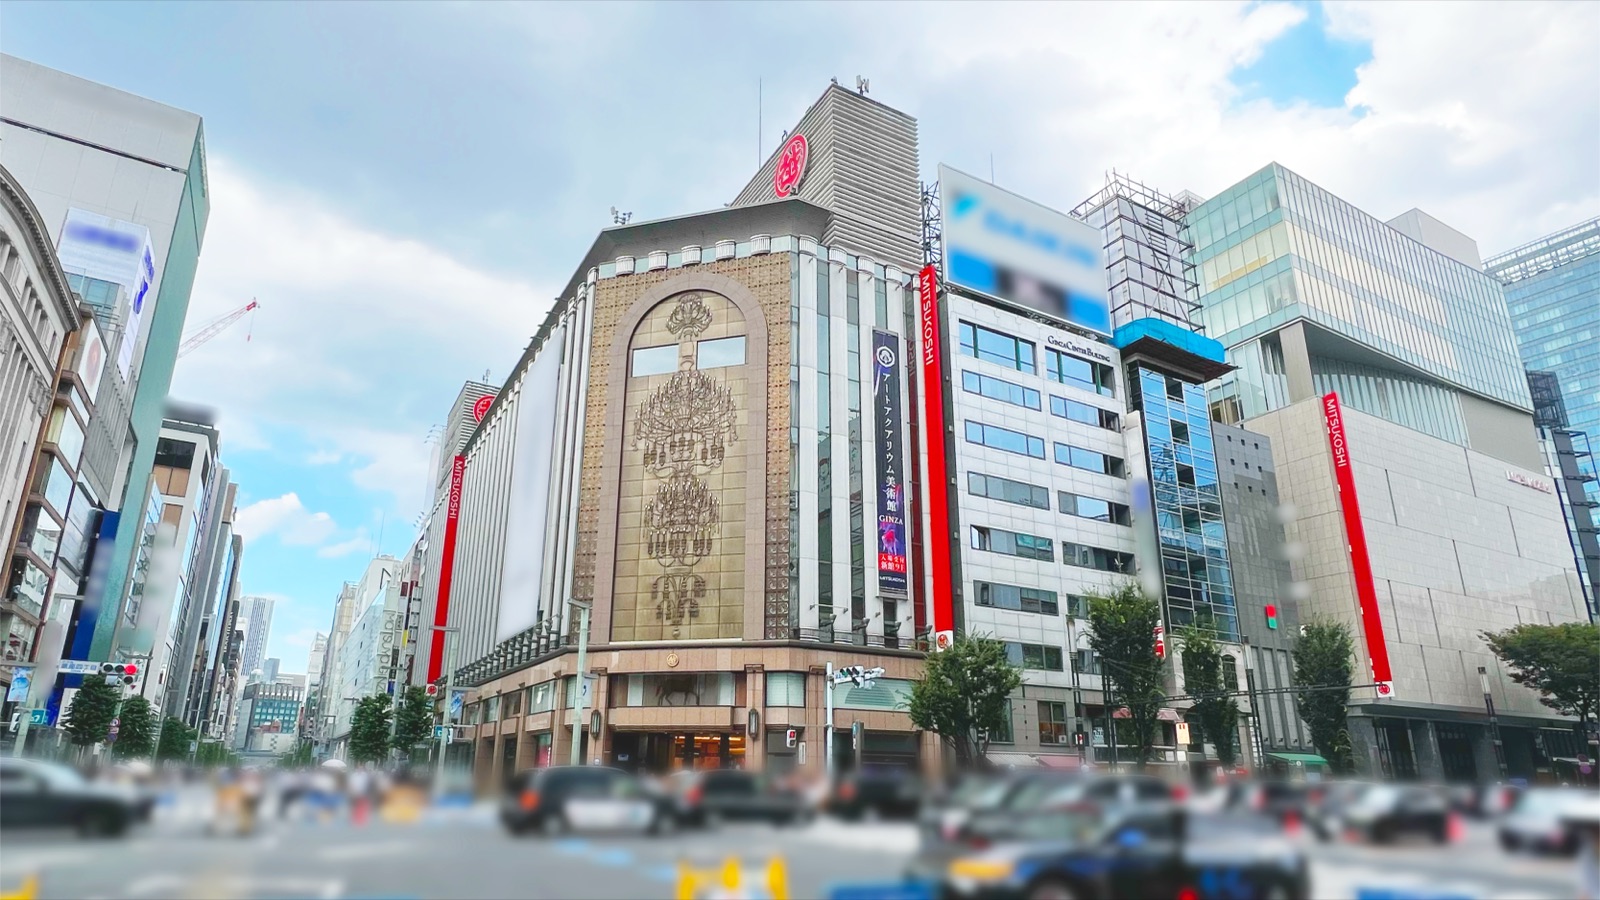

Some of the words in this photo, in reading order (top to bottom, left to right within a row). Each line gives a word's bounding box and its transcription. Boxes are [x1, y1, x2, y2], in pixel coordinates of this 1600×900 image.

[922, 273, 934, 365] MITSUKOSHI
[882, 373, 897, 511] アートアクアリウム美術館
[1326, 399, 1347, 467] MITSUKOSHI
[449, 460, 463, 519] MITSUKOSHI
[879, 514, 903, 525] GINZA
